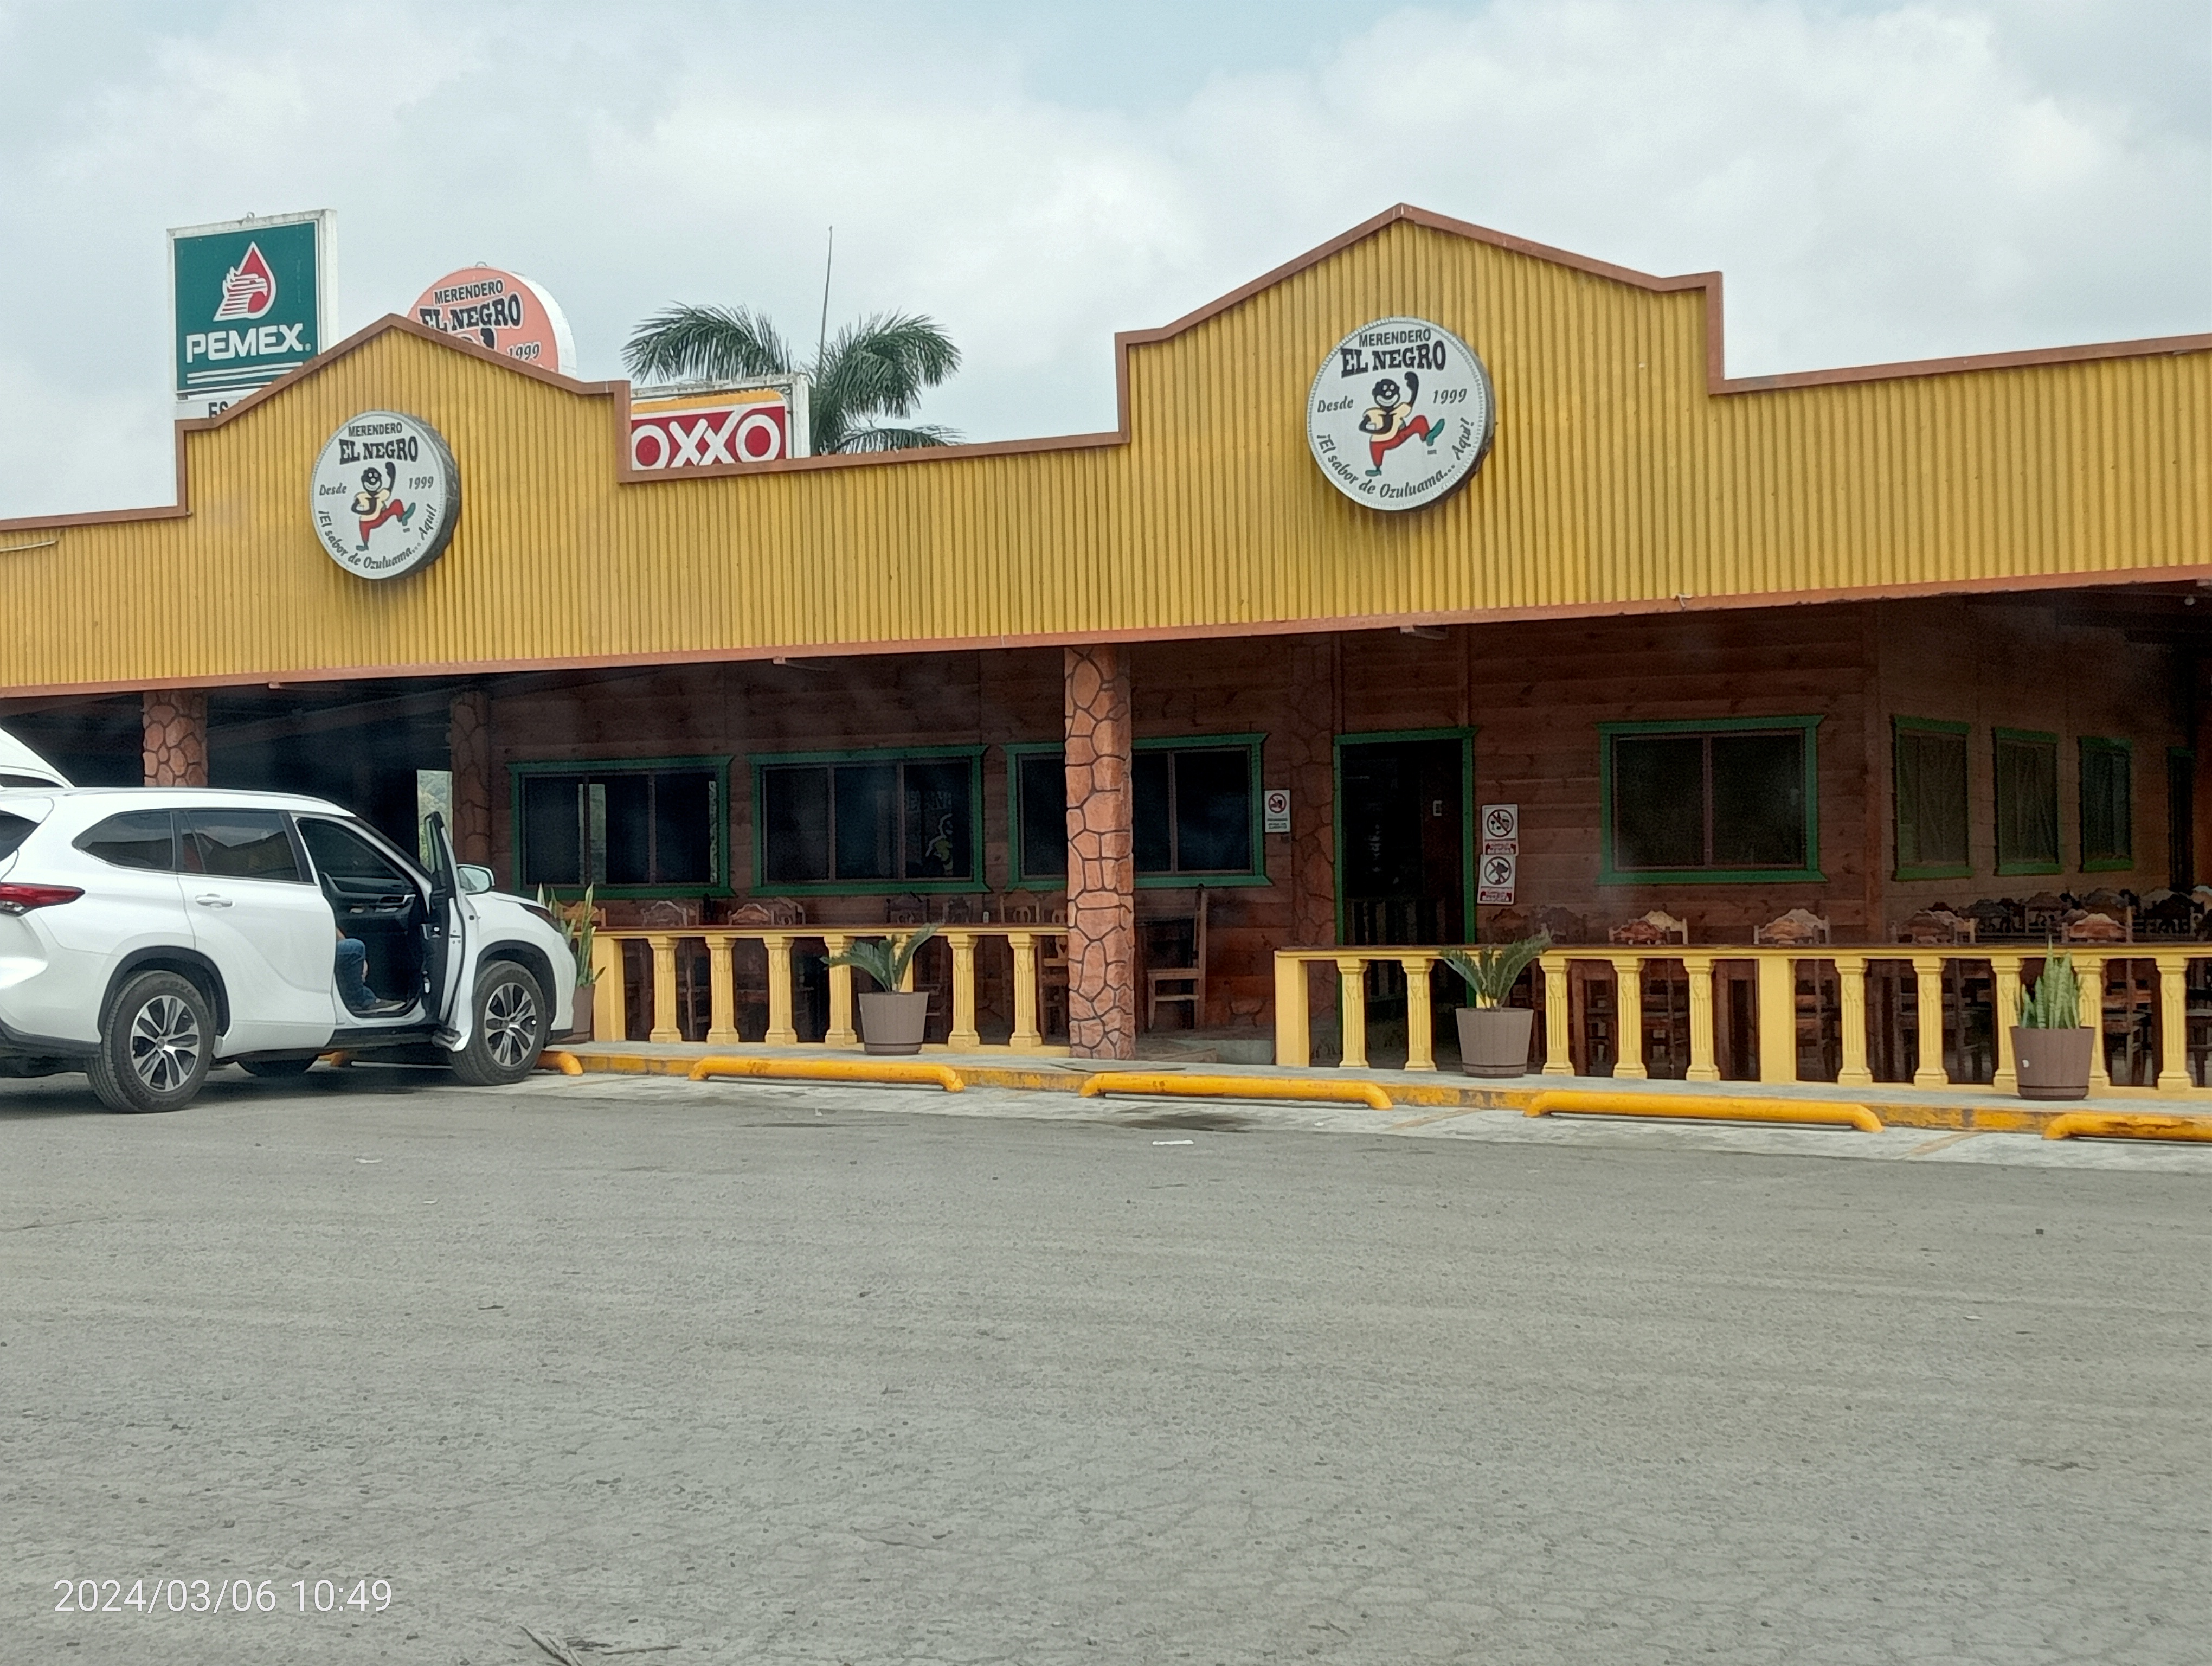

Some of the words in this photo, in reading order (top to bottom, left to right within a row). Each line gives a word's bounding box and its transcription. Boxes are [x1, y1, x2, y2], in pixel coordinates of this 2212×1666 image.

[434, 280, 503, 305] MERENDERO
[450, 293, 521, 332] NEGRO
[1359, 329, 1431, 348] MERENDERO
[1340, 348, 1369, 379] EL
[1372, 340, 1446, 371] NEGRO
[1317, 395, 1354, 413] Desde
[1433, 389, 1467, 405] 1999
[348, 422, 402, 437] MERENDERO
[631, 410, 781, 470] OXXO
[339, 438, 361, 465] EL
[363, 435, 419, 462] NEGRO
[319, 482, 347, 496] Desde
[409, 476, 433, 490] 1999
[1328, 455, 1359, 484] sabor
[1358, 479, 1376, 495] de
[325, 530, 348, 556] sabor
[348, 553, 361, 565] de
